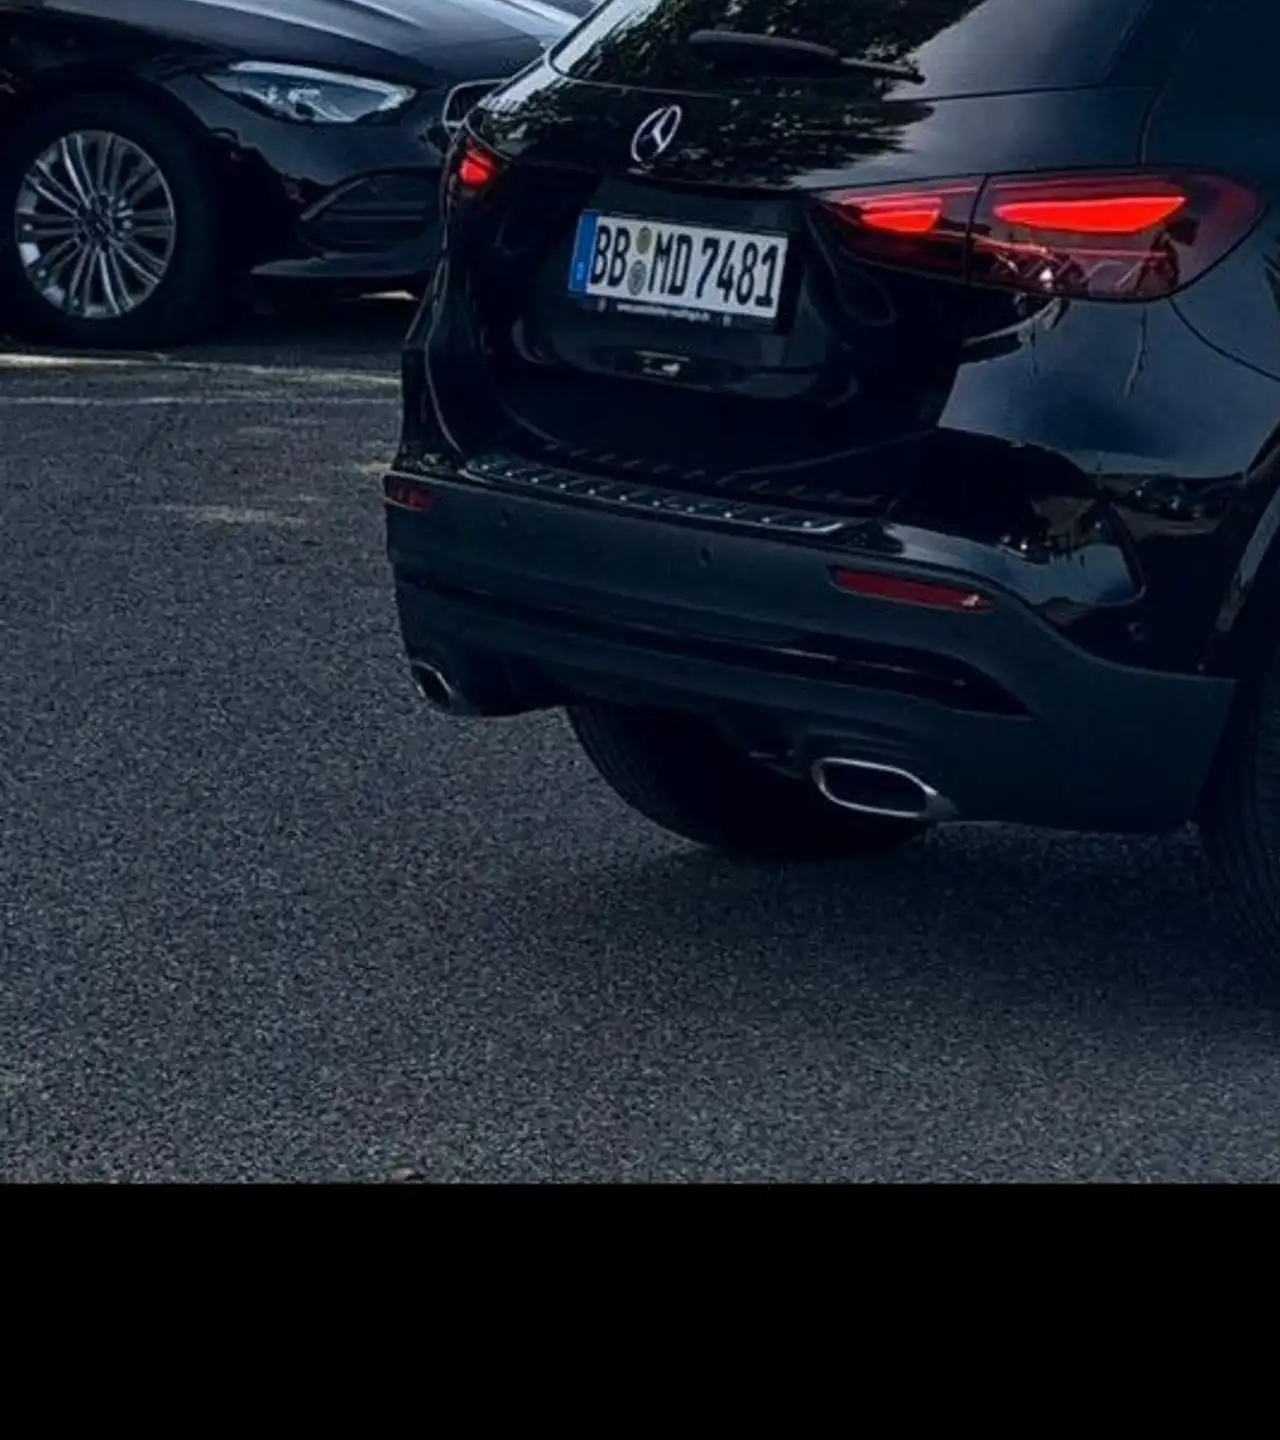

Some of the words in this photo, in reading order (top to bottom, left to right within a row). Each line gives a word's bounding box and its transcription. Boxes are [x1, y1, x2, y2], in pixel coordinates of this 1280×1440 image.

[590, 226, 630, 287] BB
[648, 230, 693, 296] MD
[695, 237, 779, 308] 7481
